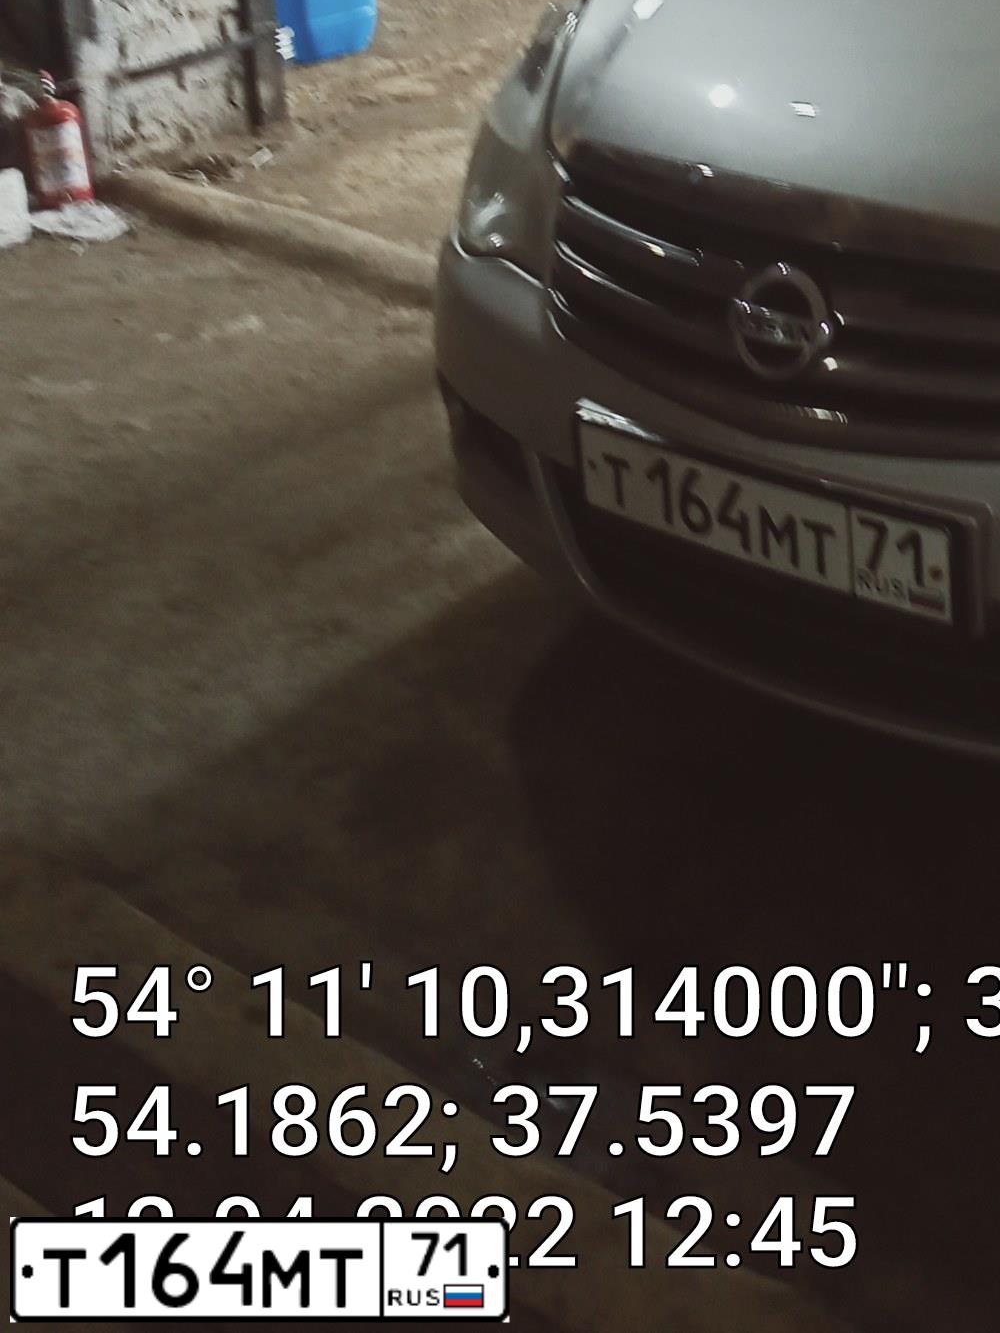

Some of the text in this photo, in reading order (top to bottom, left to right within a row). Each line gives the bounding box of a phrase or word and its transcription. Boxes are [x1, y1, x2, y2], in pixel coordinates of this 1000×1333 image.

[603, 453, 925, 587] Т164МТ 71
[856, 565, 904, 596] RUS
